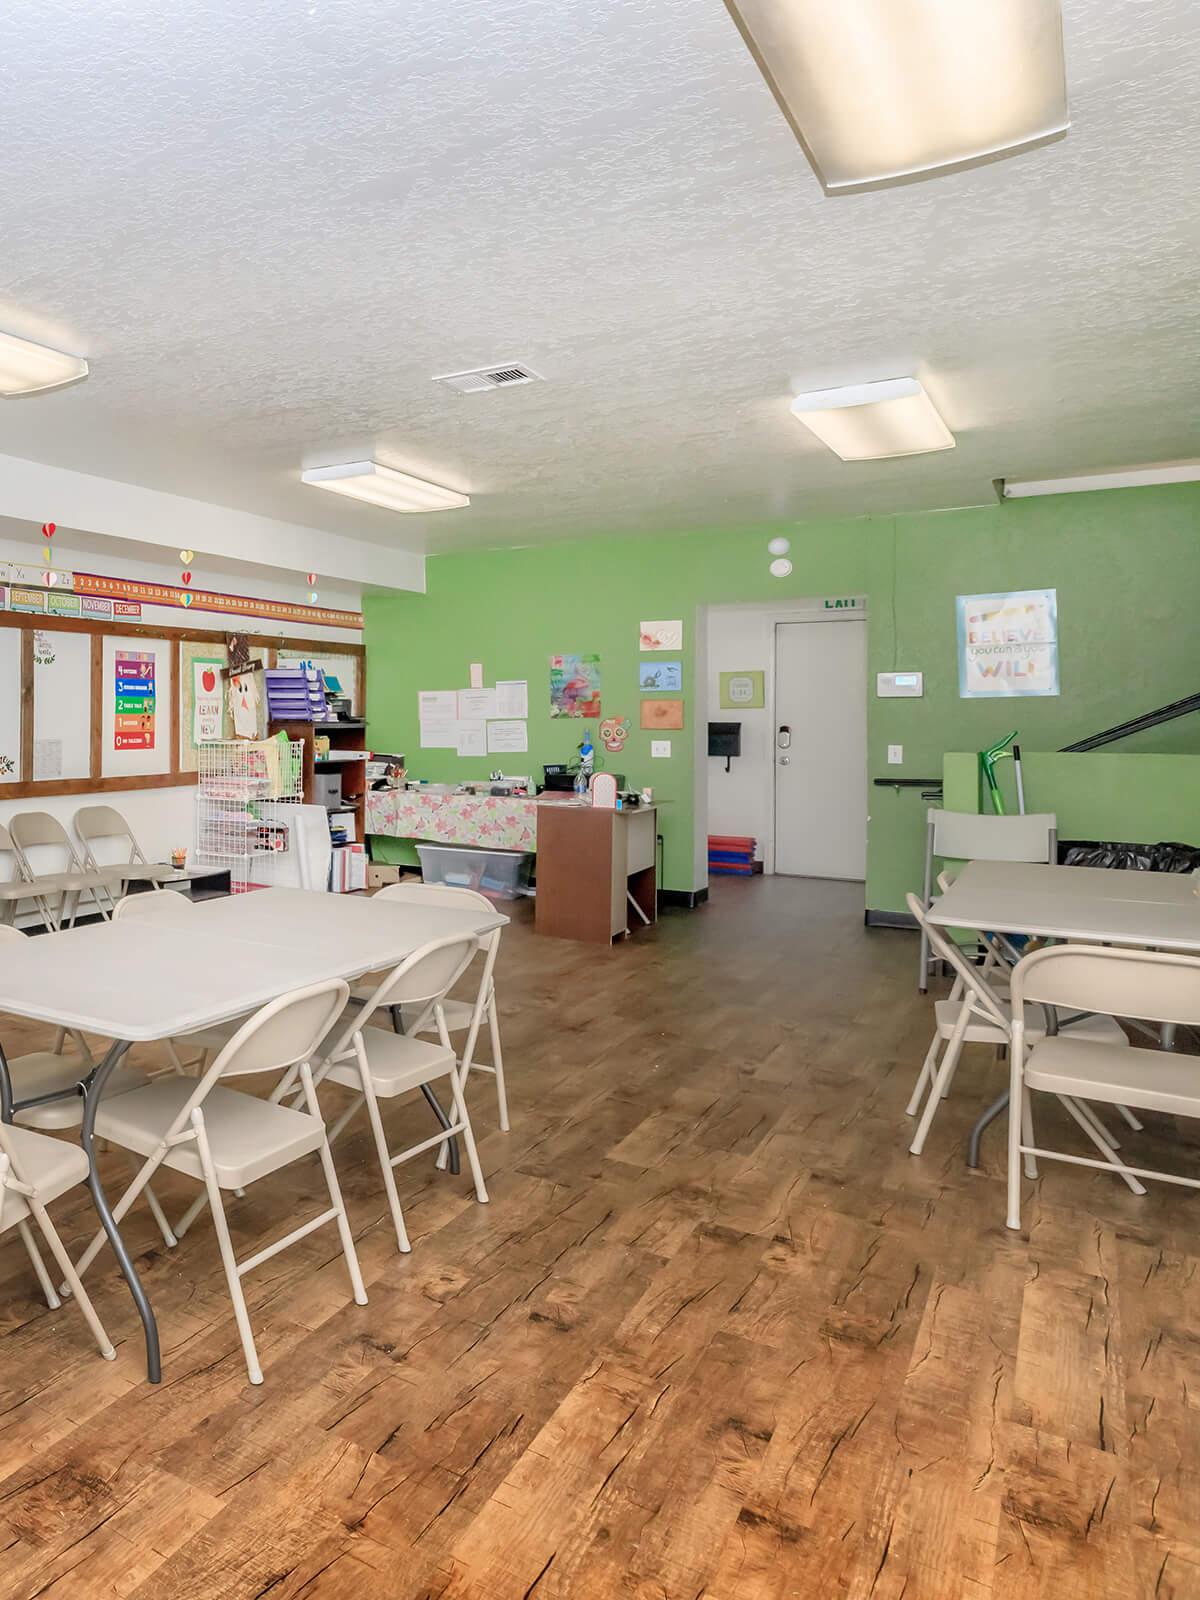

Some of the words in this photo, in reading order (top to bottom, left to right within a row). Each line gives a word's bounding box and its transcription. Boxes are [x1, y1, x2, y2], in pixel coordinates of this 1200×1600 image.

[16, 567, 25, 579] Xx
[61, 573, 70, 585] Zz
[82, 600, 111, 612] NOVEMBER
[115, 603, 140, 614] DECEMBER
[968, 628, 1046, 644] BELIEVE
[970, 646, 993, 656] you
[993, 645, 1013, 655] can
[118, 665, 123, 676] 4
[118, 681, 123, 692] 3
[118, 700, 123, 710] 2
[119, 717, 123, 728] 1
[116, 735, 122, 746] 0
